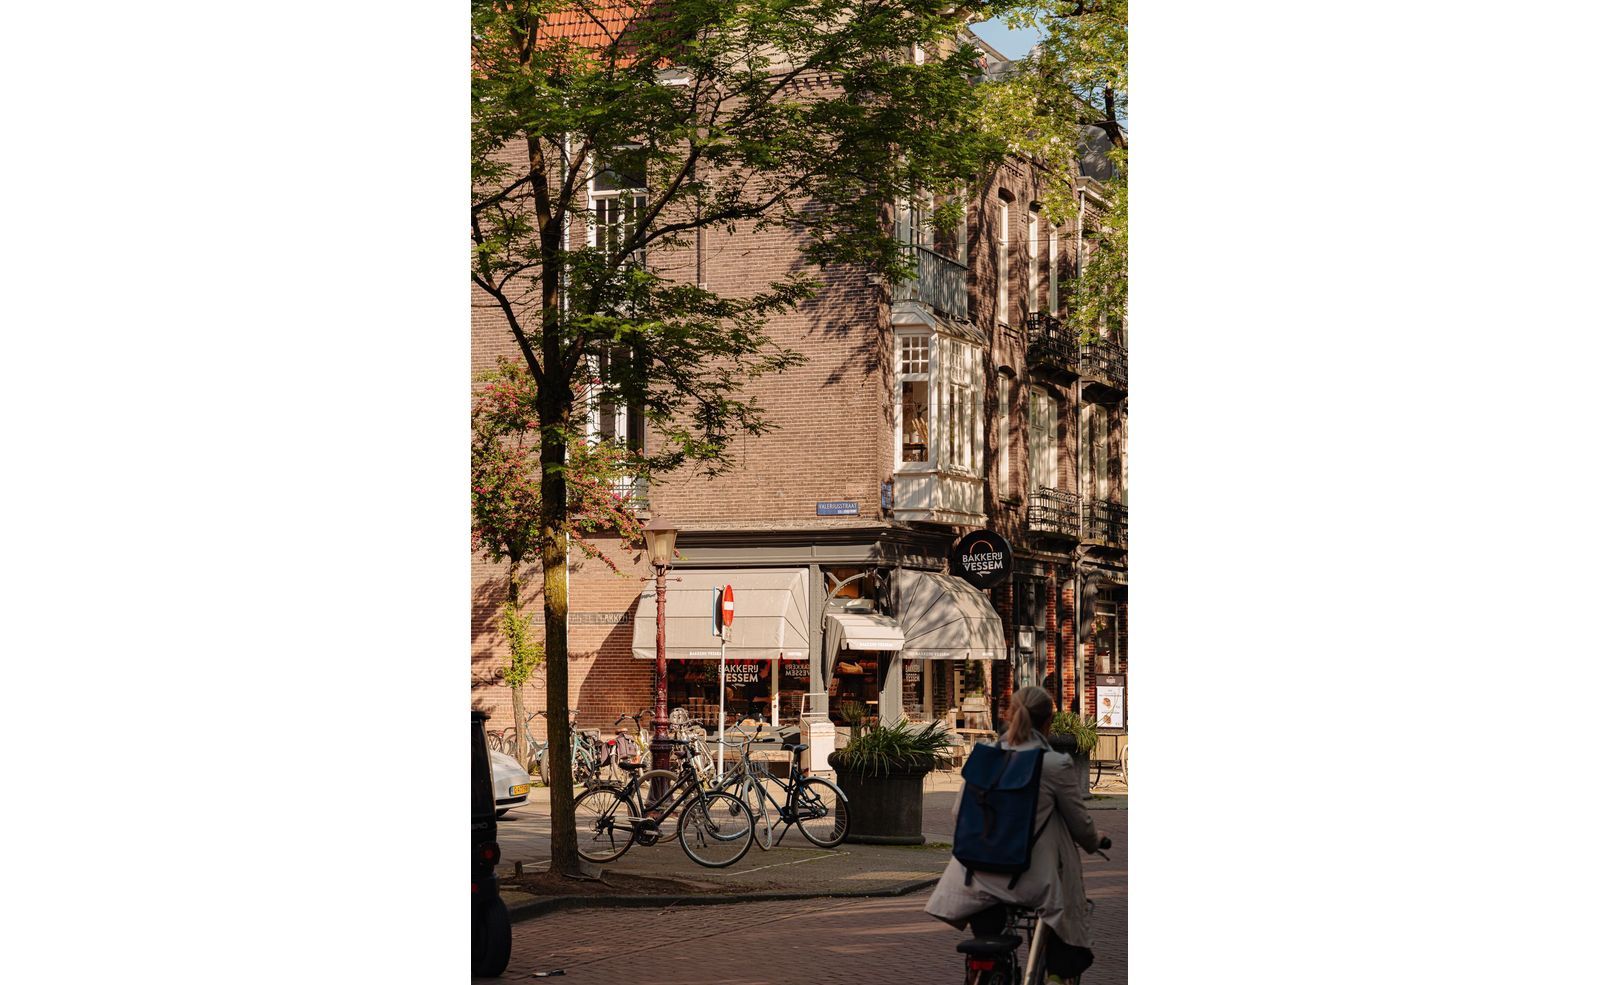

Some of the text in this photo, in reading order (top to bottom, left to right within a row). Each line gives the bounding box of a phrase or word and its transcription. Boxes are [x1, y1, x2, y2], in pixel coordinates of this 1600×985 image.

[962, 551, 1003, 563] BAKKERIJ
[963, 560, 1003, 572] VESSEM
[718, 672, 759, 683] ESSEM
